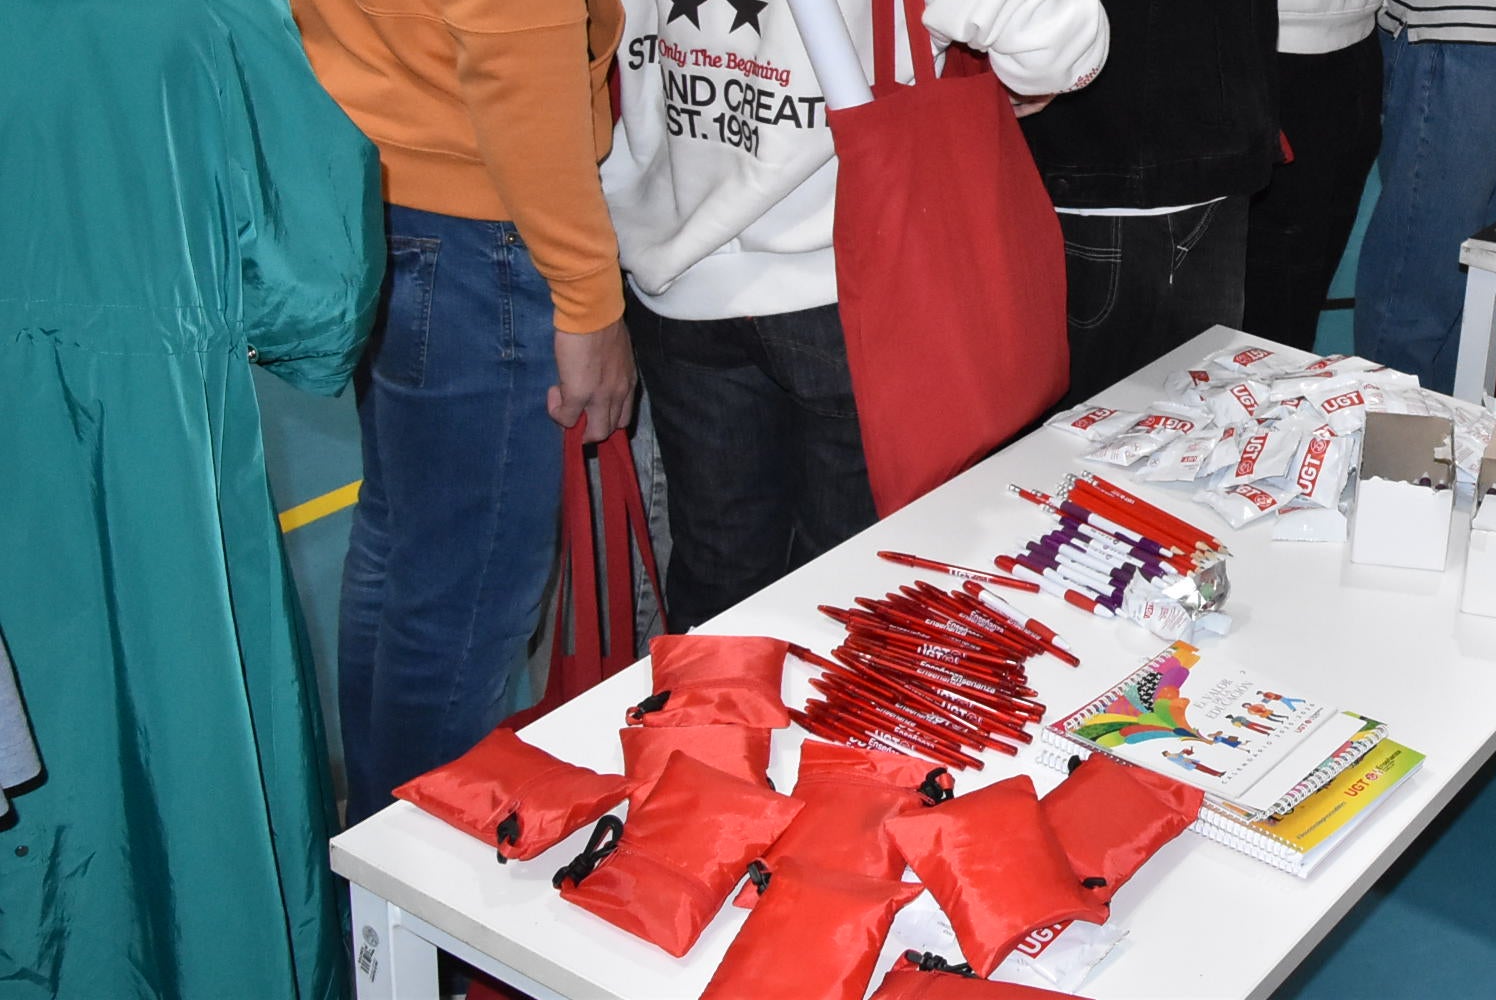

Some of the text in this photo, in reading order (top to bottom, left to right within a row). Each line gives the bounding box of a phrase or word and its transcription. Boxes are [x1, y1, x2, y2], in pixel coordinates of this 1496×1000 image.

[659, 39, 687, 67] Only
[690, 48, 722, 69] The
[724, 78, 829, 129] CREAT
[667, 104, 760, 159] ST. 1991
[1324, 391, 1361, 413] UGT
[1300, 454, 1321, 495] UGT
[1344, 778, 1370, 797] UGT
